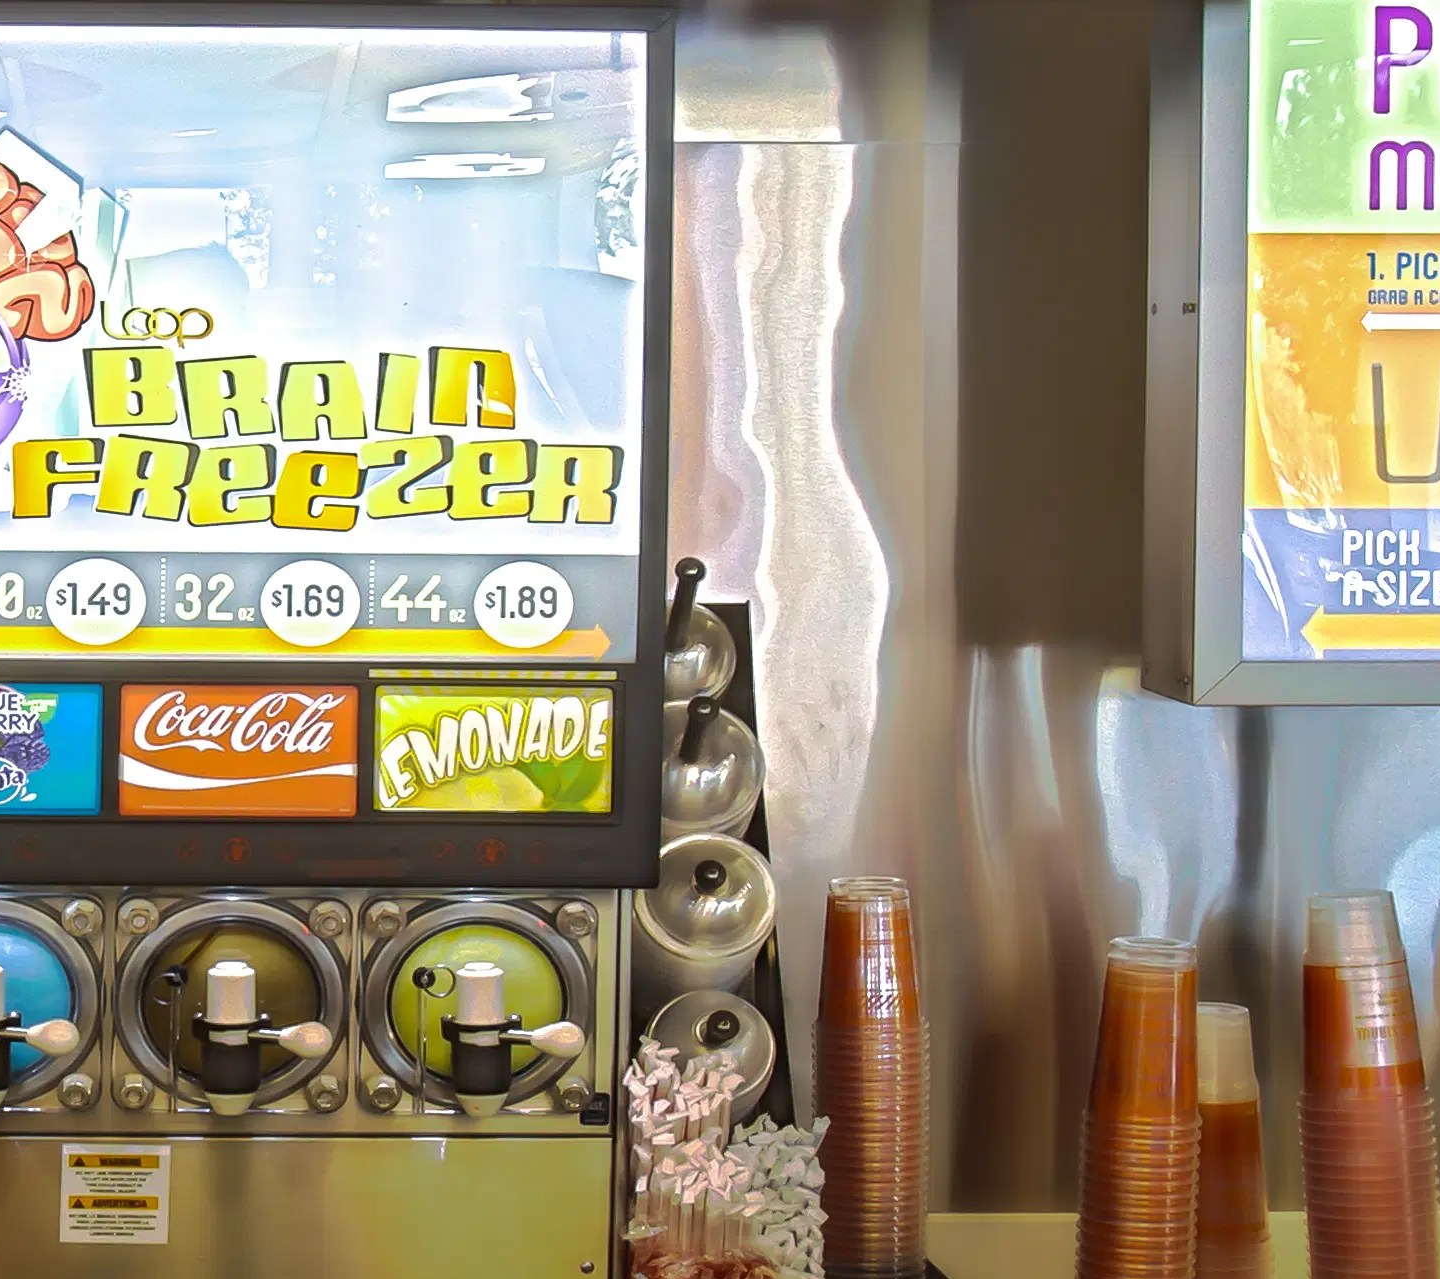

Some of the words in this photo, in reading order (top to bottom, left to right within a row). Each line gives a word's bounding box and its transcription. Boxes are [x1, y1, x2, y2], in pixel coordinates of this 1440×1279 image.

[1366, 253, 1385, 280] 1.
[1368, 290, 1409, 305] GRAB
[1414, 290, 1425, 305] A
[83, 346, 517, 441] BRAIN
[12, 434, 626, 532] FREEZER
[1342, 530, 1420, 566] PICK
[56, 582, 131, 617] $1.49
[175, 573, 234, 621] 32
[271, 583, 345, 617] $1.69
[380, 574, 448, 623] 44
[485, 584, 558, 619] $1.89
[133, 690, 347, 754] Coca-Cola
[379, 696, 610, 808] LEMONADE
